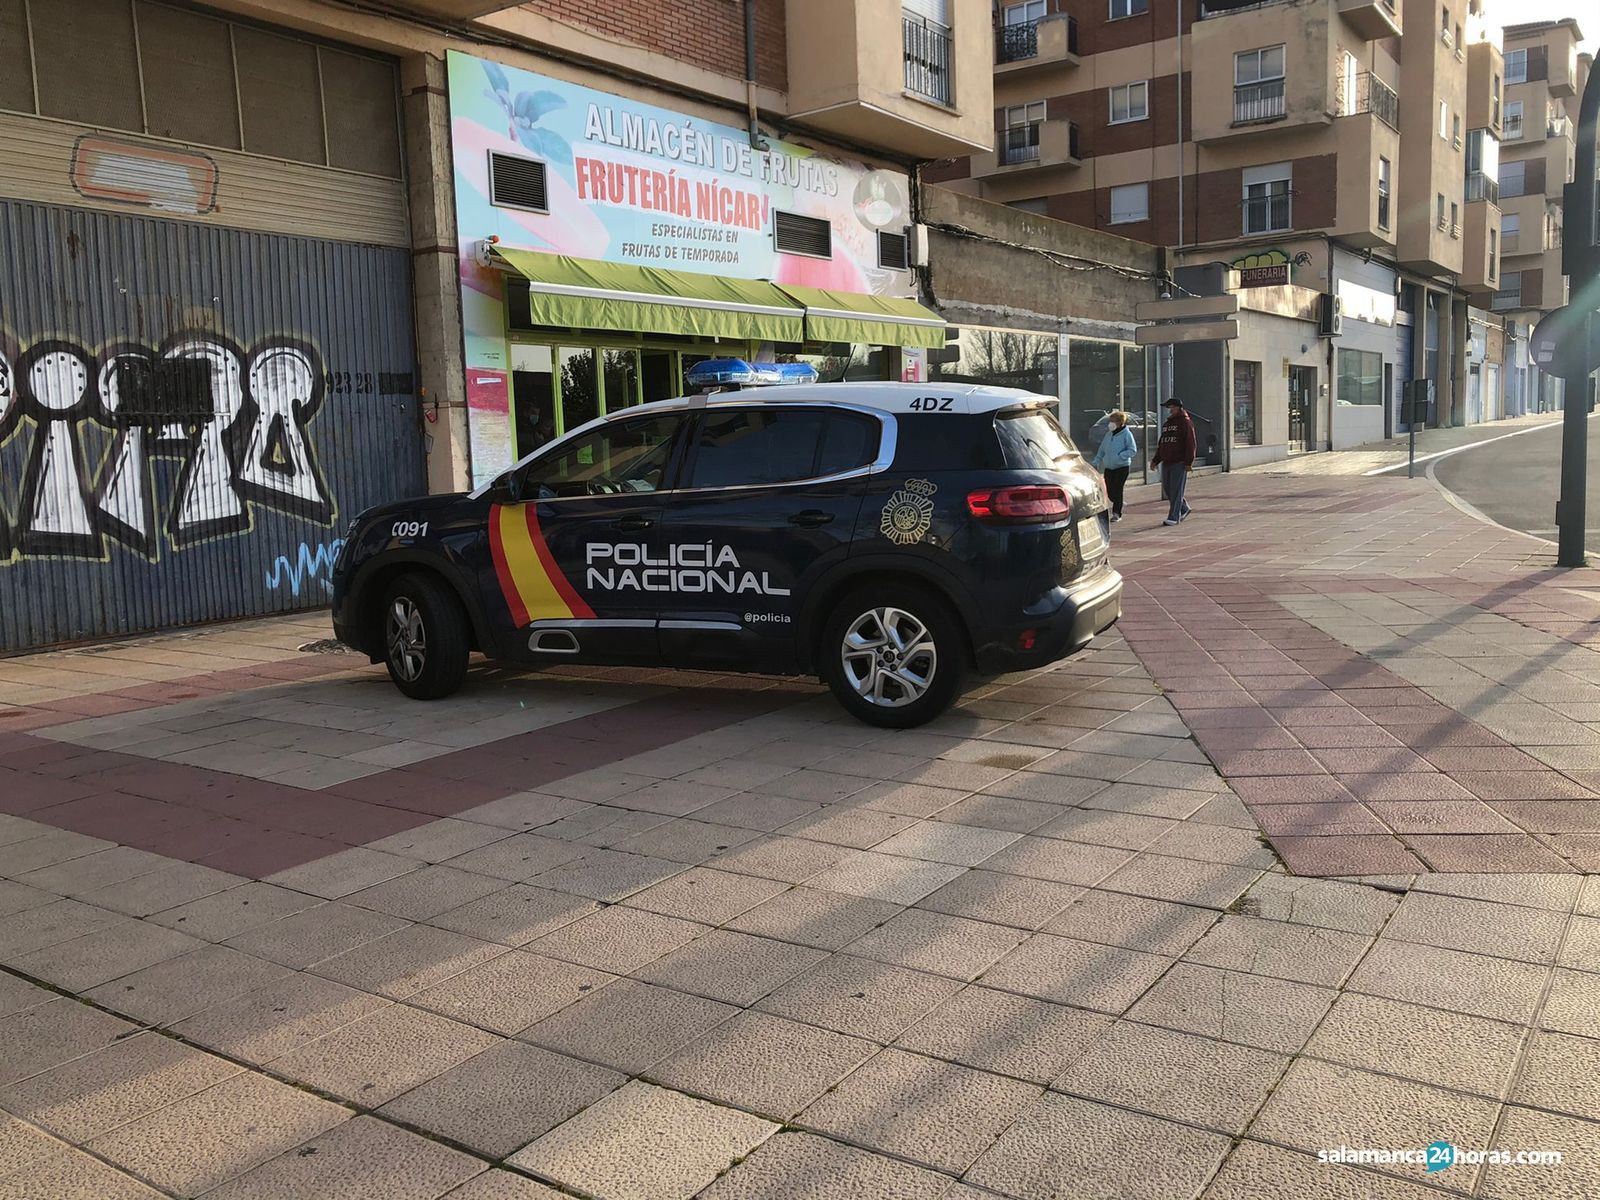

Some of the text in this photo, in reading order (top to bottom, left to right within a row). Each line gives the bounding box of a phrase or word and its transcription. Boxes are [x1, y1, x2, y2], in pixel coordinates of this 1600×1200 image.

[584, 103, 839, 197] ALMACÉN DE FRUTAS
[574, 156, 692, 218] FRUTERÍA
[651, 223, 739, 243] ESPECIALISTAS EN
[622, 242, 739, 264] FRUTAS DE TEMPORADA
[1242, 267, 1286, 280] FUNERARIA
[325, 372, 373, 394] 923 28
[909, 397, 954, 411] 4DZ
[586, 539, 741, 568] POLICÍA
[586, 567, 791, 596] NACIONAL
[744, 612, 791, 623] @policia
